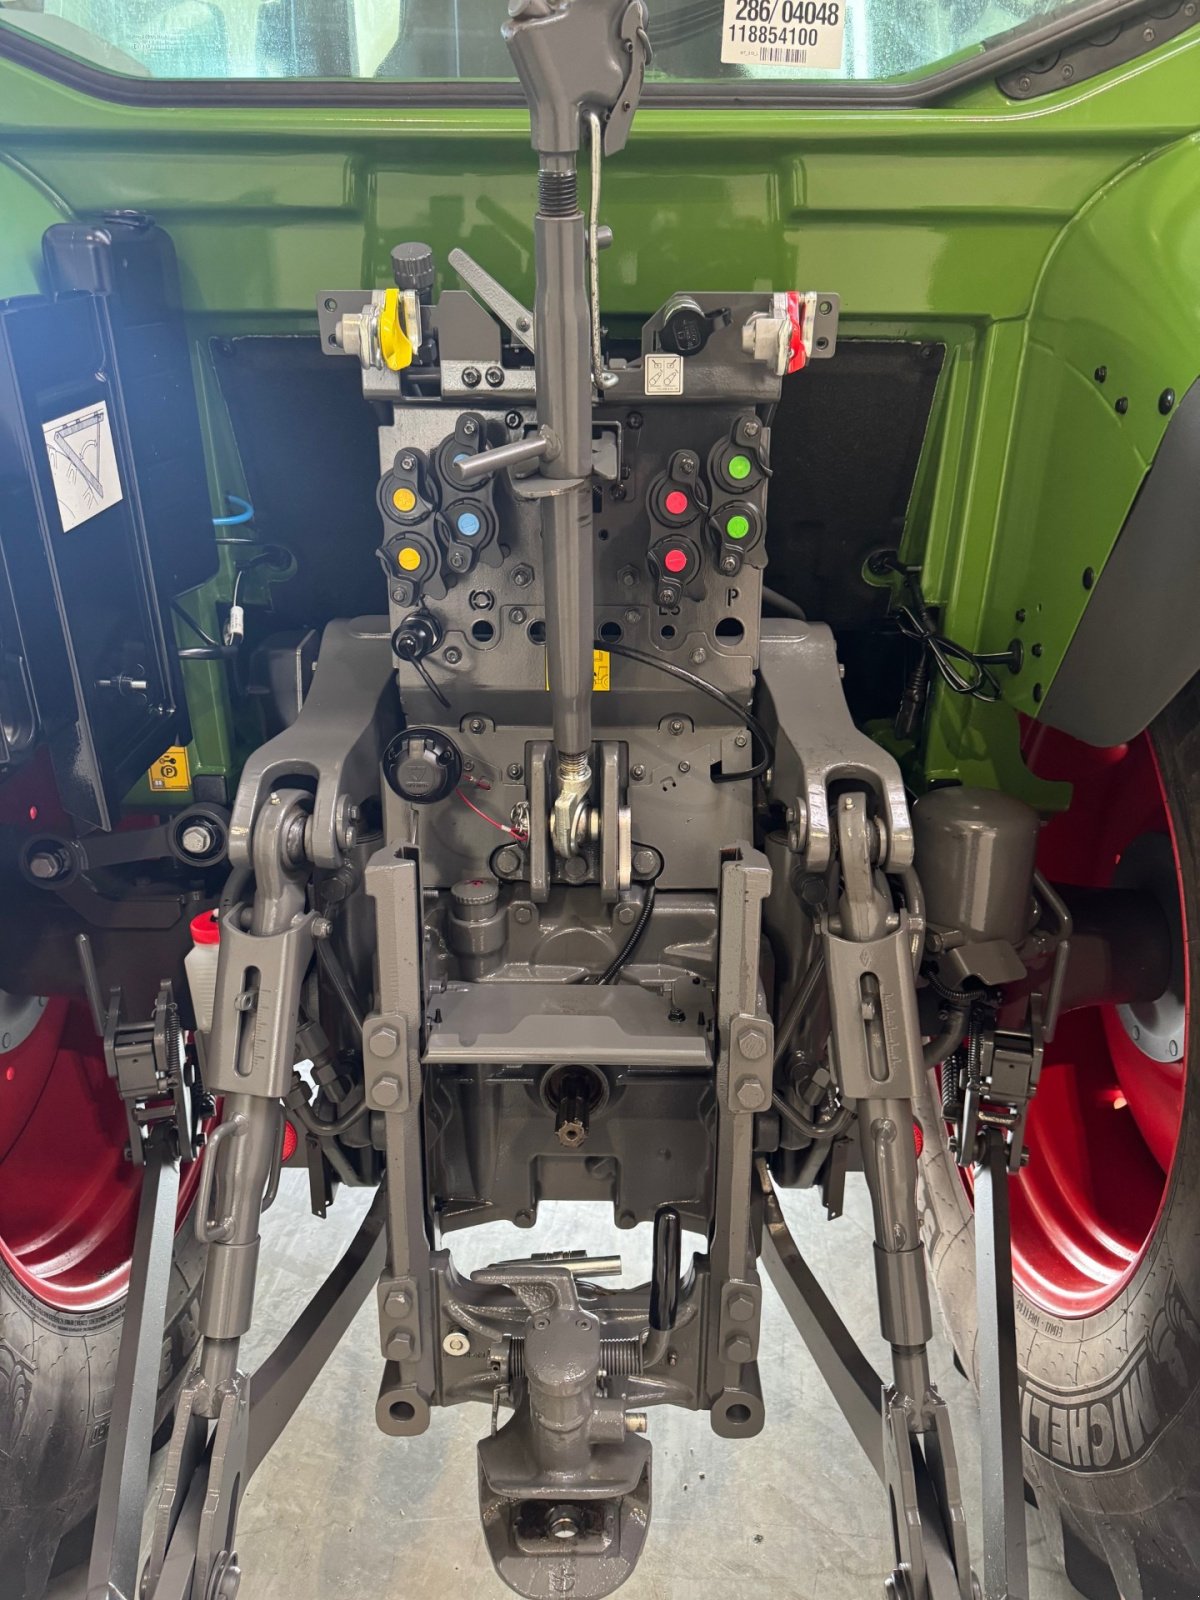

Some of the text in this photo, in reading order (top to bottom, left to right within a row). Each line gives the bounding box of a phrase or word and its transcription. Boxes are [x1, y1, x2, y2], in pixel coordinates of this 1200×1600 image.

[729, 24, 818, 46] 118854100
[728, 588, 740, 606] P
[1018, 1357, 1161, 1467] MICHELI
